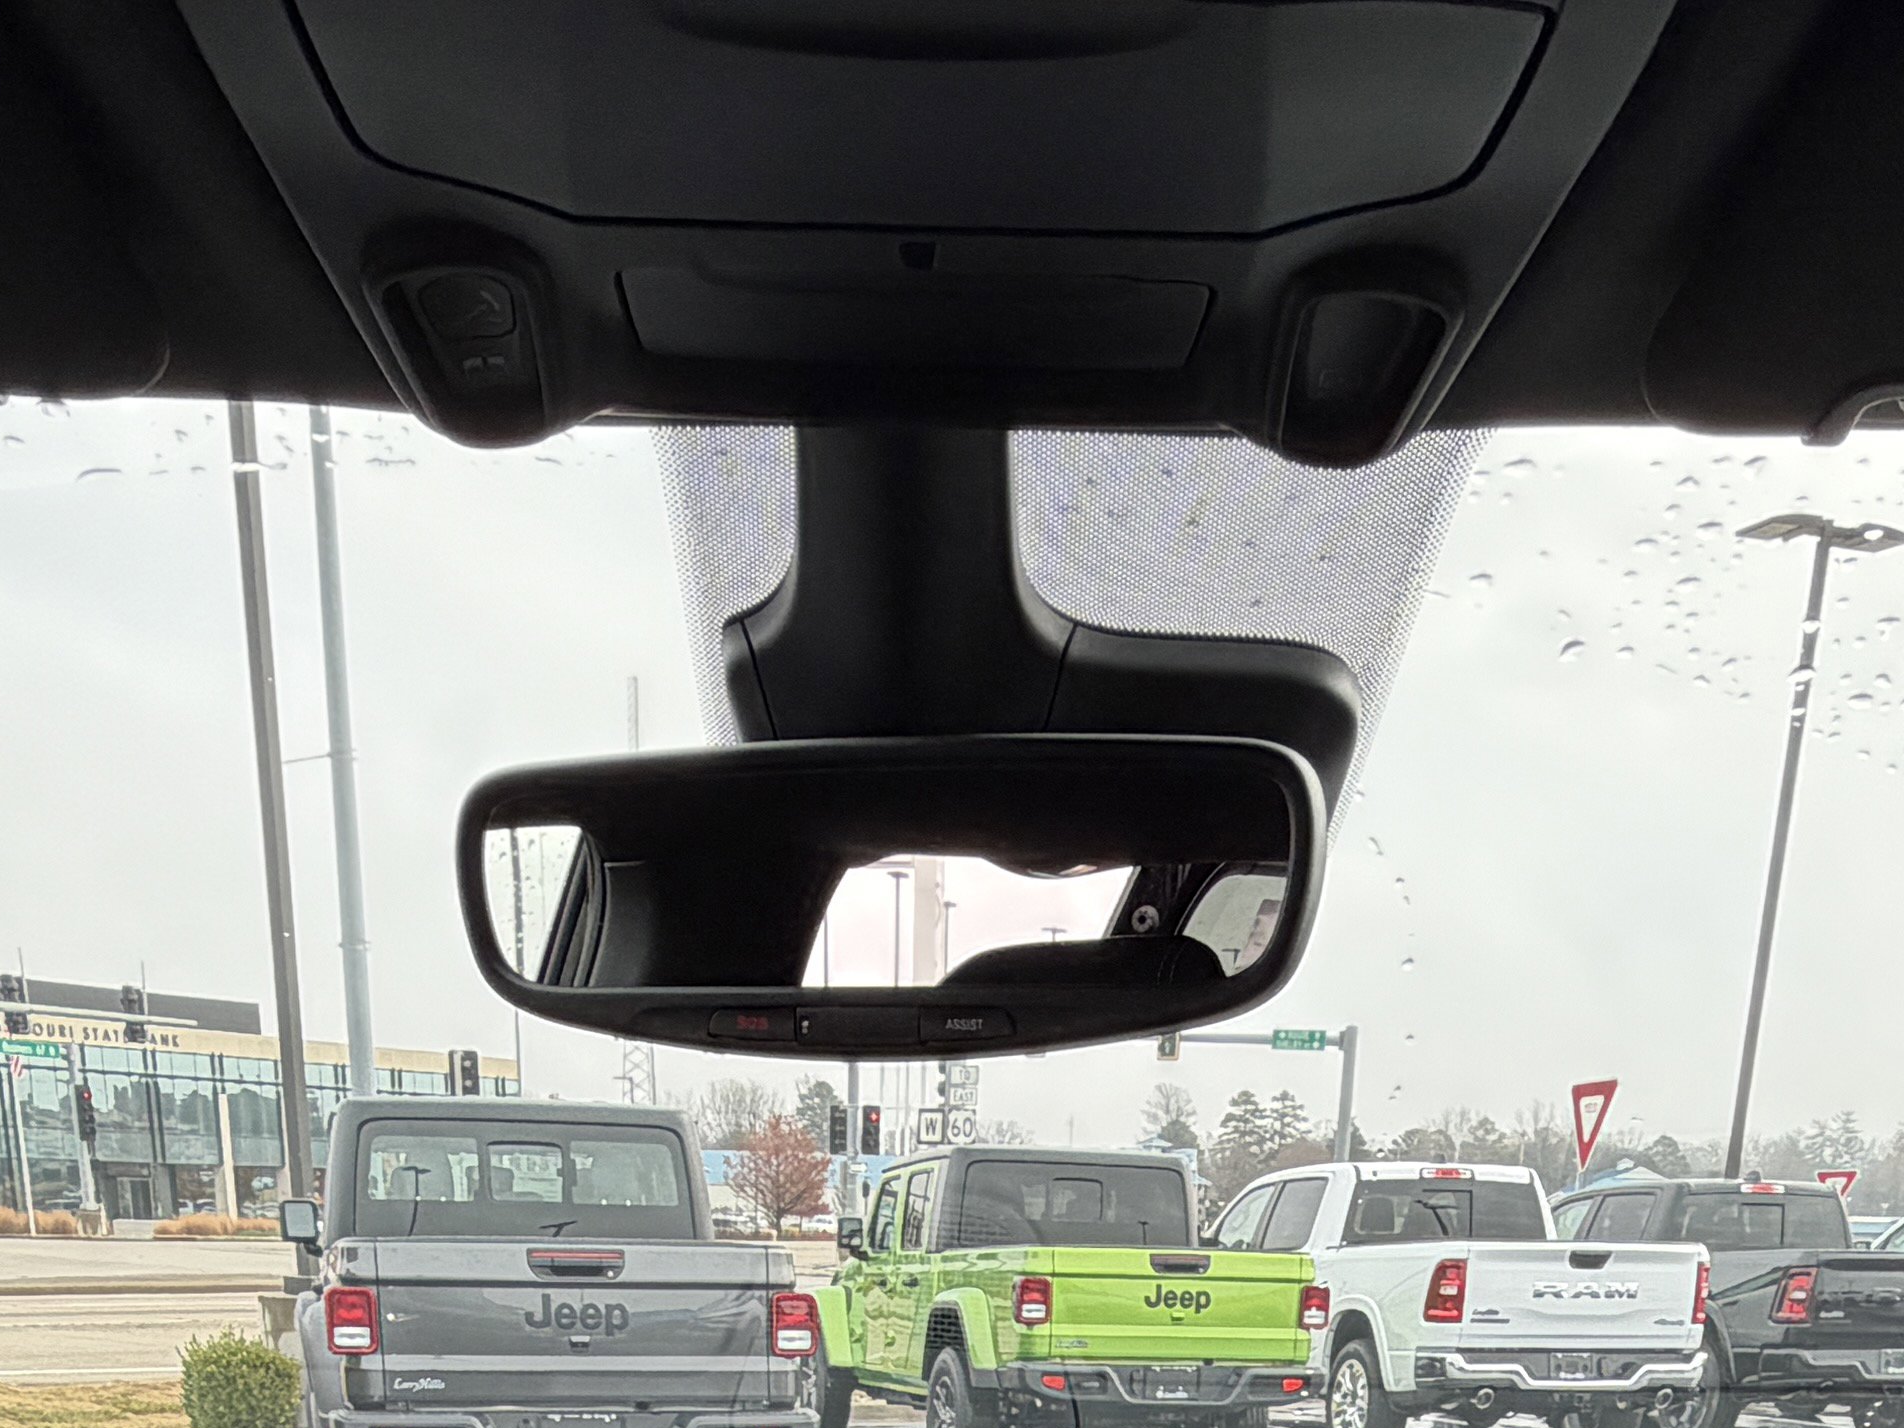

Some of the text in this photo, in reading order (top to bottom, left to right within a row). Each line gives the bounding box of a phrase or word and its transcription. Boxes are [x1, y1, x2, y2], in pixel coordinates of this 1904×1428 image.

[945, 1018, 983, 1031] ASSIST
[83, 1023, 128, 1043] STAT
[149, 1032, 181, 1048] ANK
[953, 1091, 974, 1102] EAST
[924, 1117, 938, 1137] W
[951, 1117, 974, 1138] 60
[1144, 1283, 1211, 1314] Jeep
[1532, 1281, 1640, 1299] RAM
[525, 1293, 630, 1337] Jeep
